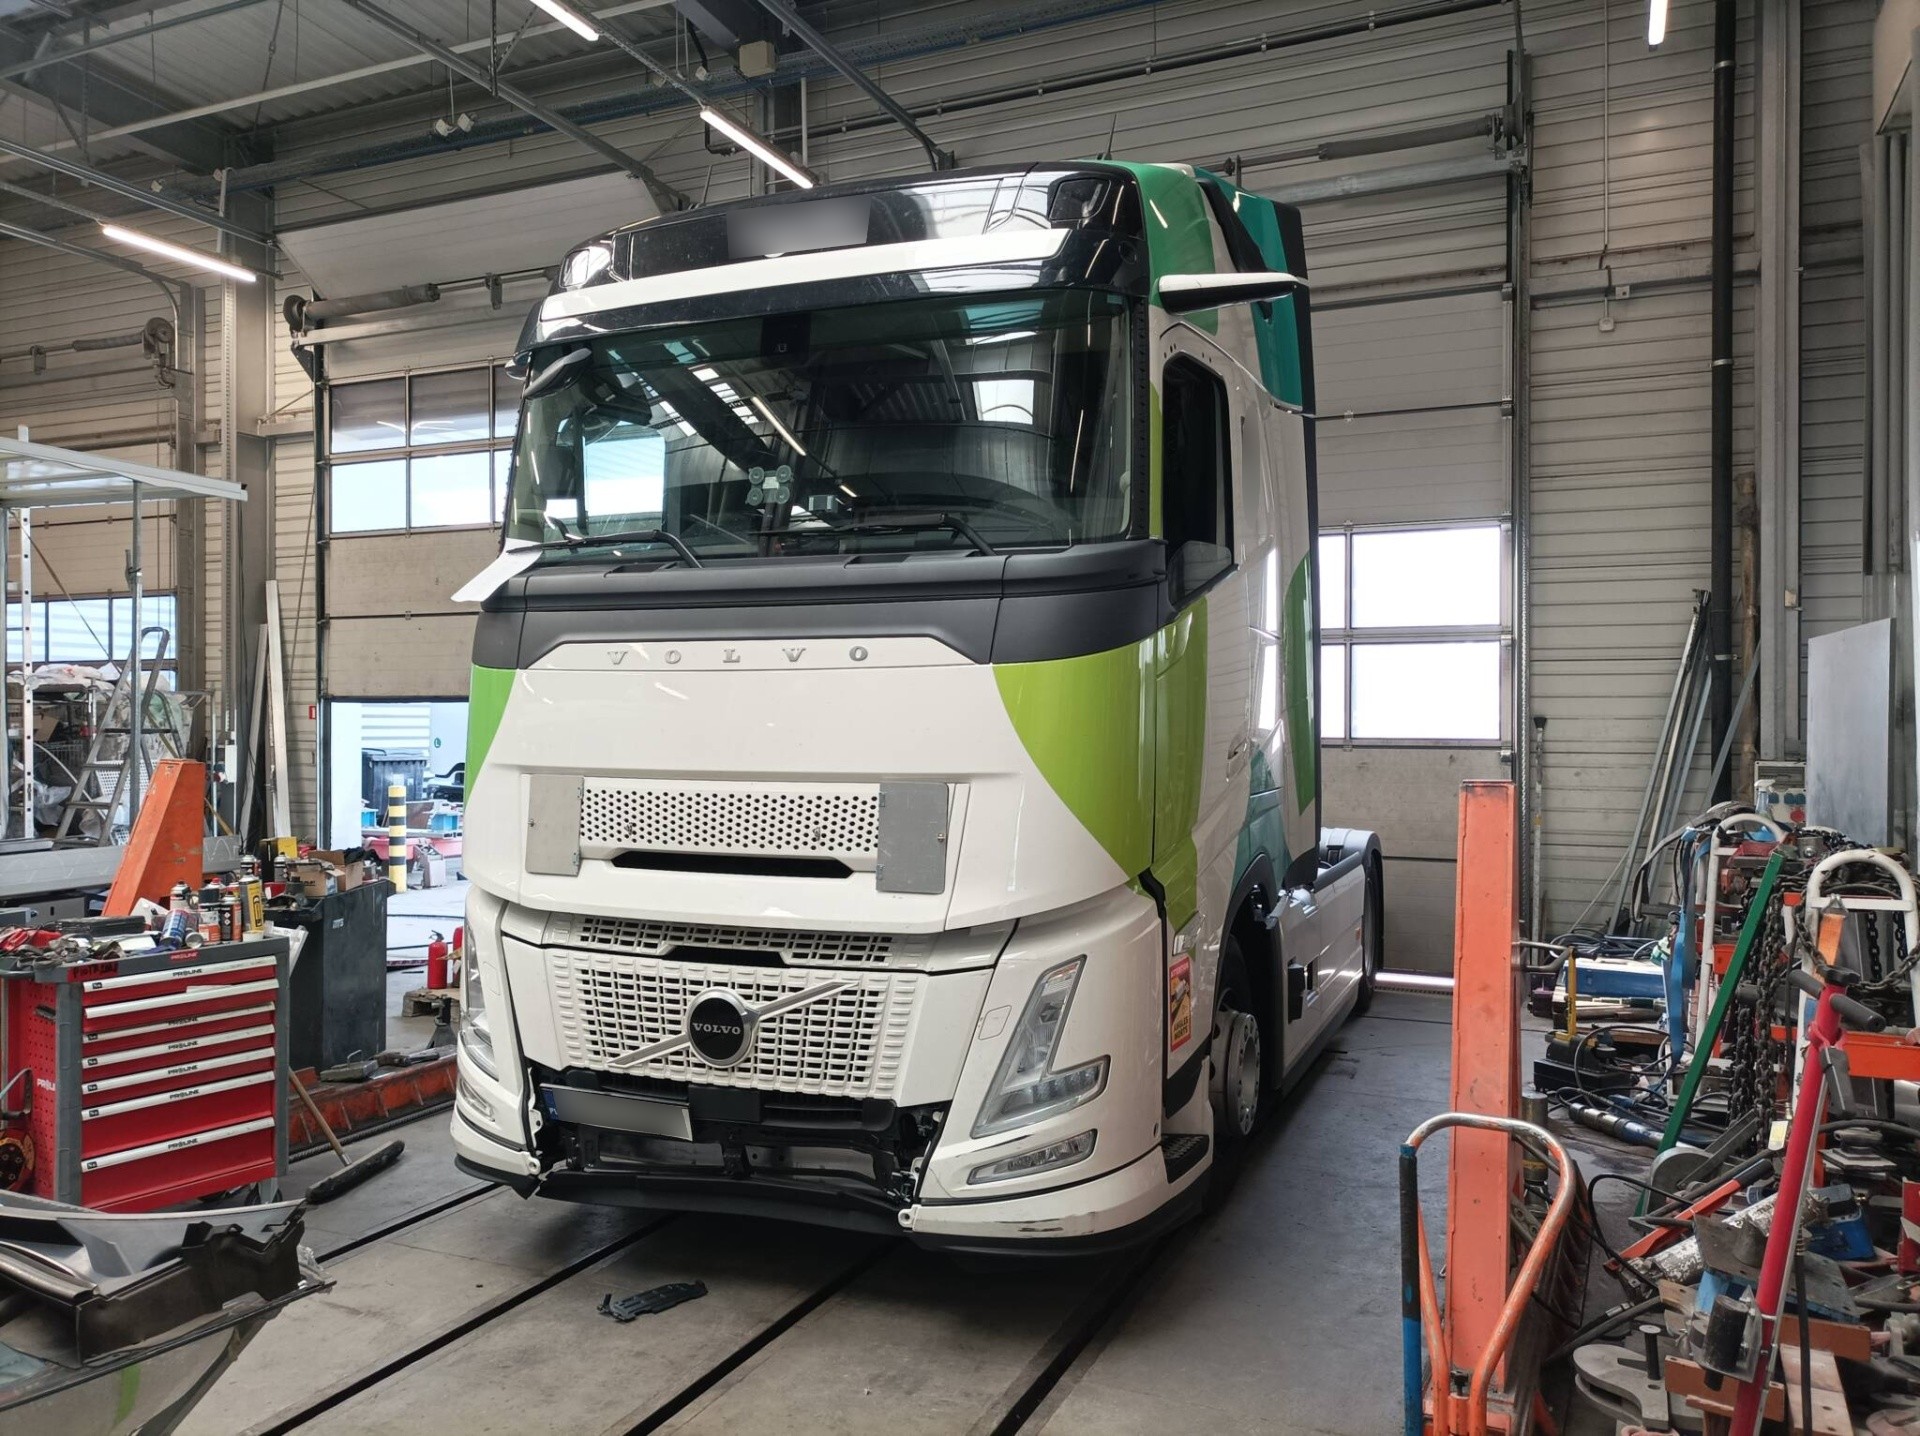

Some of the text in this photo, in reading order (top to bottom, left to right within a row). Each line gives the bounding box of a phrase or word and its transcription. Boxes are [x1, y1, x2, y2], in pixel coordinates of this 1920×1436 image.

[607, 645, 869, 665] VOLVO
[172, 968, 203, 977] PROLINE
[692, 1022, 741, 1035] VOLVO
[168, 1040, 199, 1050] PROLINE
[168, 1064, 199, 1075] PROLINE
[169, 1089, 200, 1099] PROLINE
[168, 1138, 198, 1149] PROLINE
